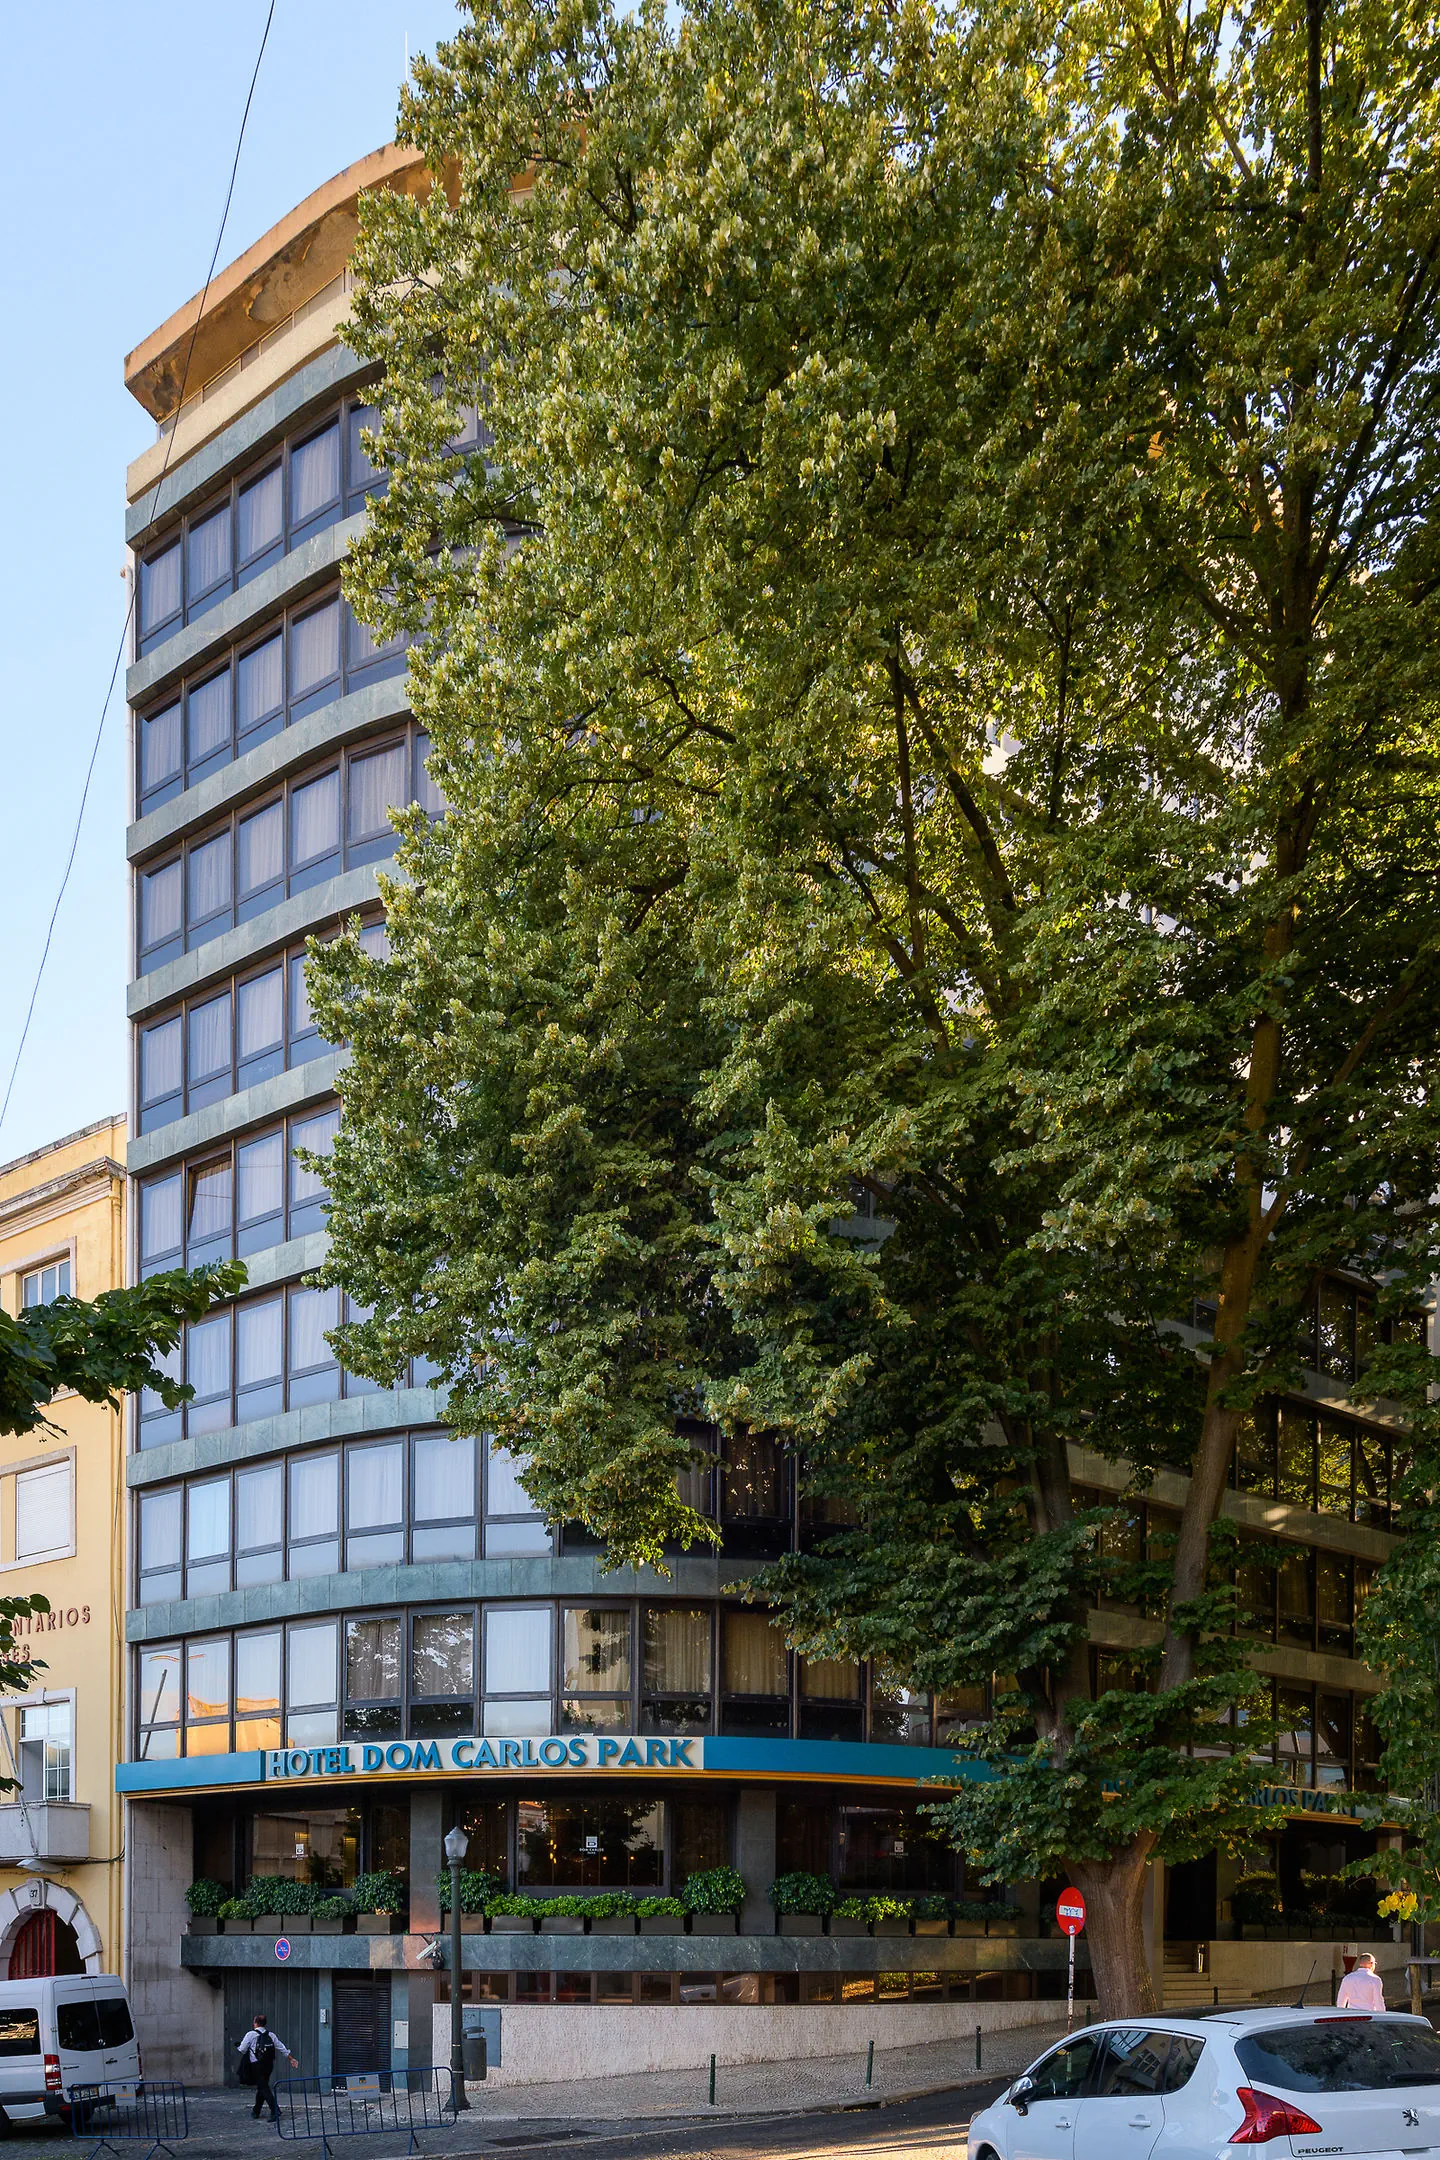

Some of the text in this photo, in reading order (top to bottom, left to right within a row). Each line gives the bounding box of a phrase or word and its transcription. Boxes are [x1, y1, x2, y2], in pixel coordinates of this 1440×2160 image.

[12, 1605, 91, 1636] NTARIOS
[269, 1738, 694, 1777] HOTEL DOM CARLOS PARK
[1235, 1786, 1356, 1818] ARLOS PA
[30, 1889, 38, 1898] 37
[1298, 2146, 1344, 2154] PEUGEOT
